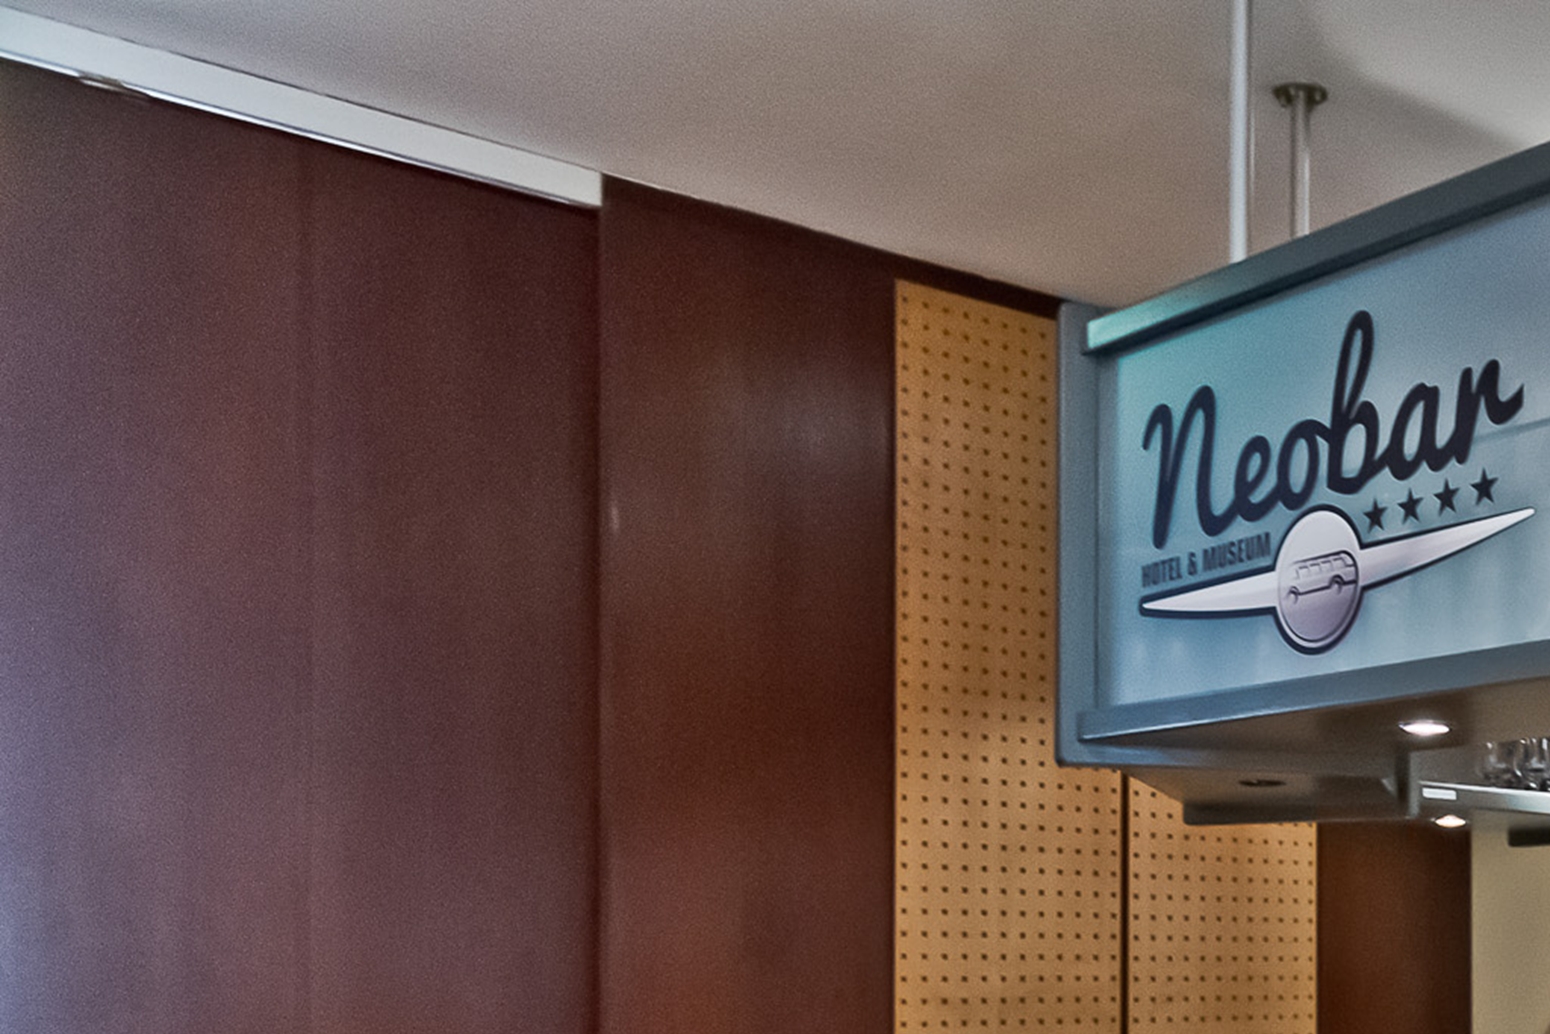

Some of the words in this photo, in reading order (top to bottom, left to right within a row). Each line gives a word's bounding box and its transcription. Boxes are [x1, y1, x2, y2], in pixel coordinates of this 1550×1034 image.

[1141, 556, 1182, 588] HOTEL
[1186, 551, 1198, 576] &
[1202, 531, 1271, 572] MUSEUM
